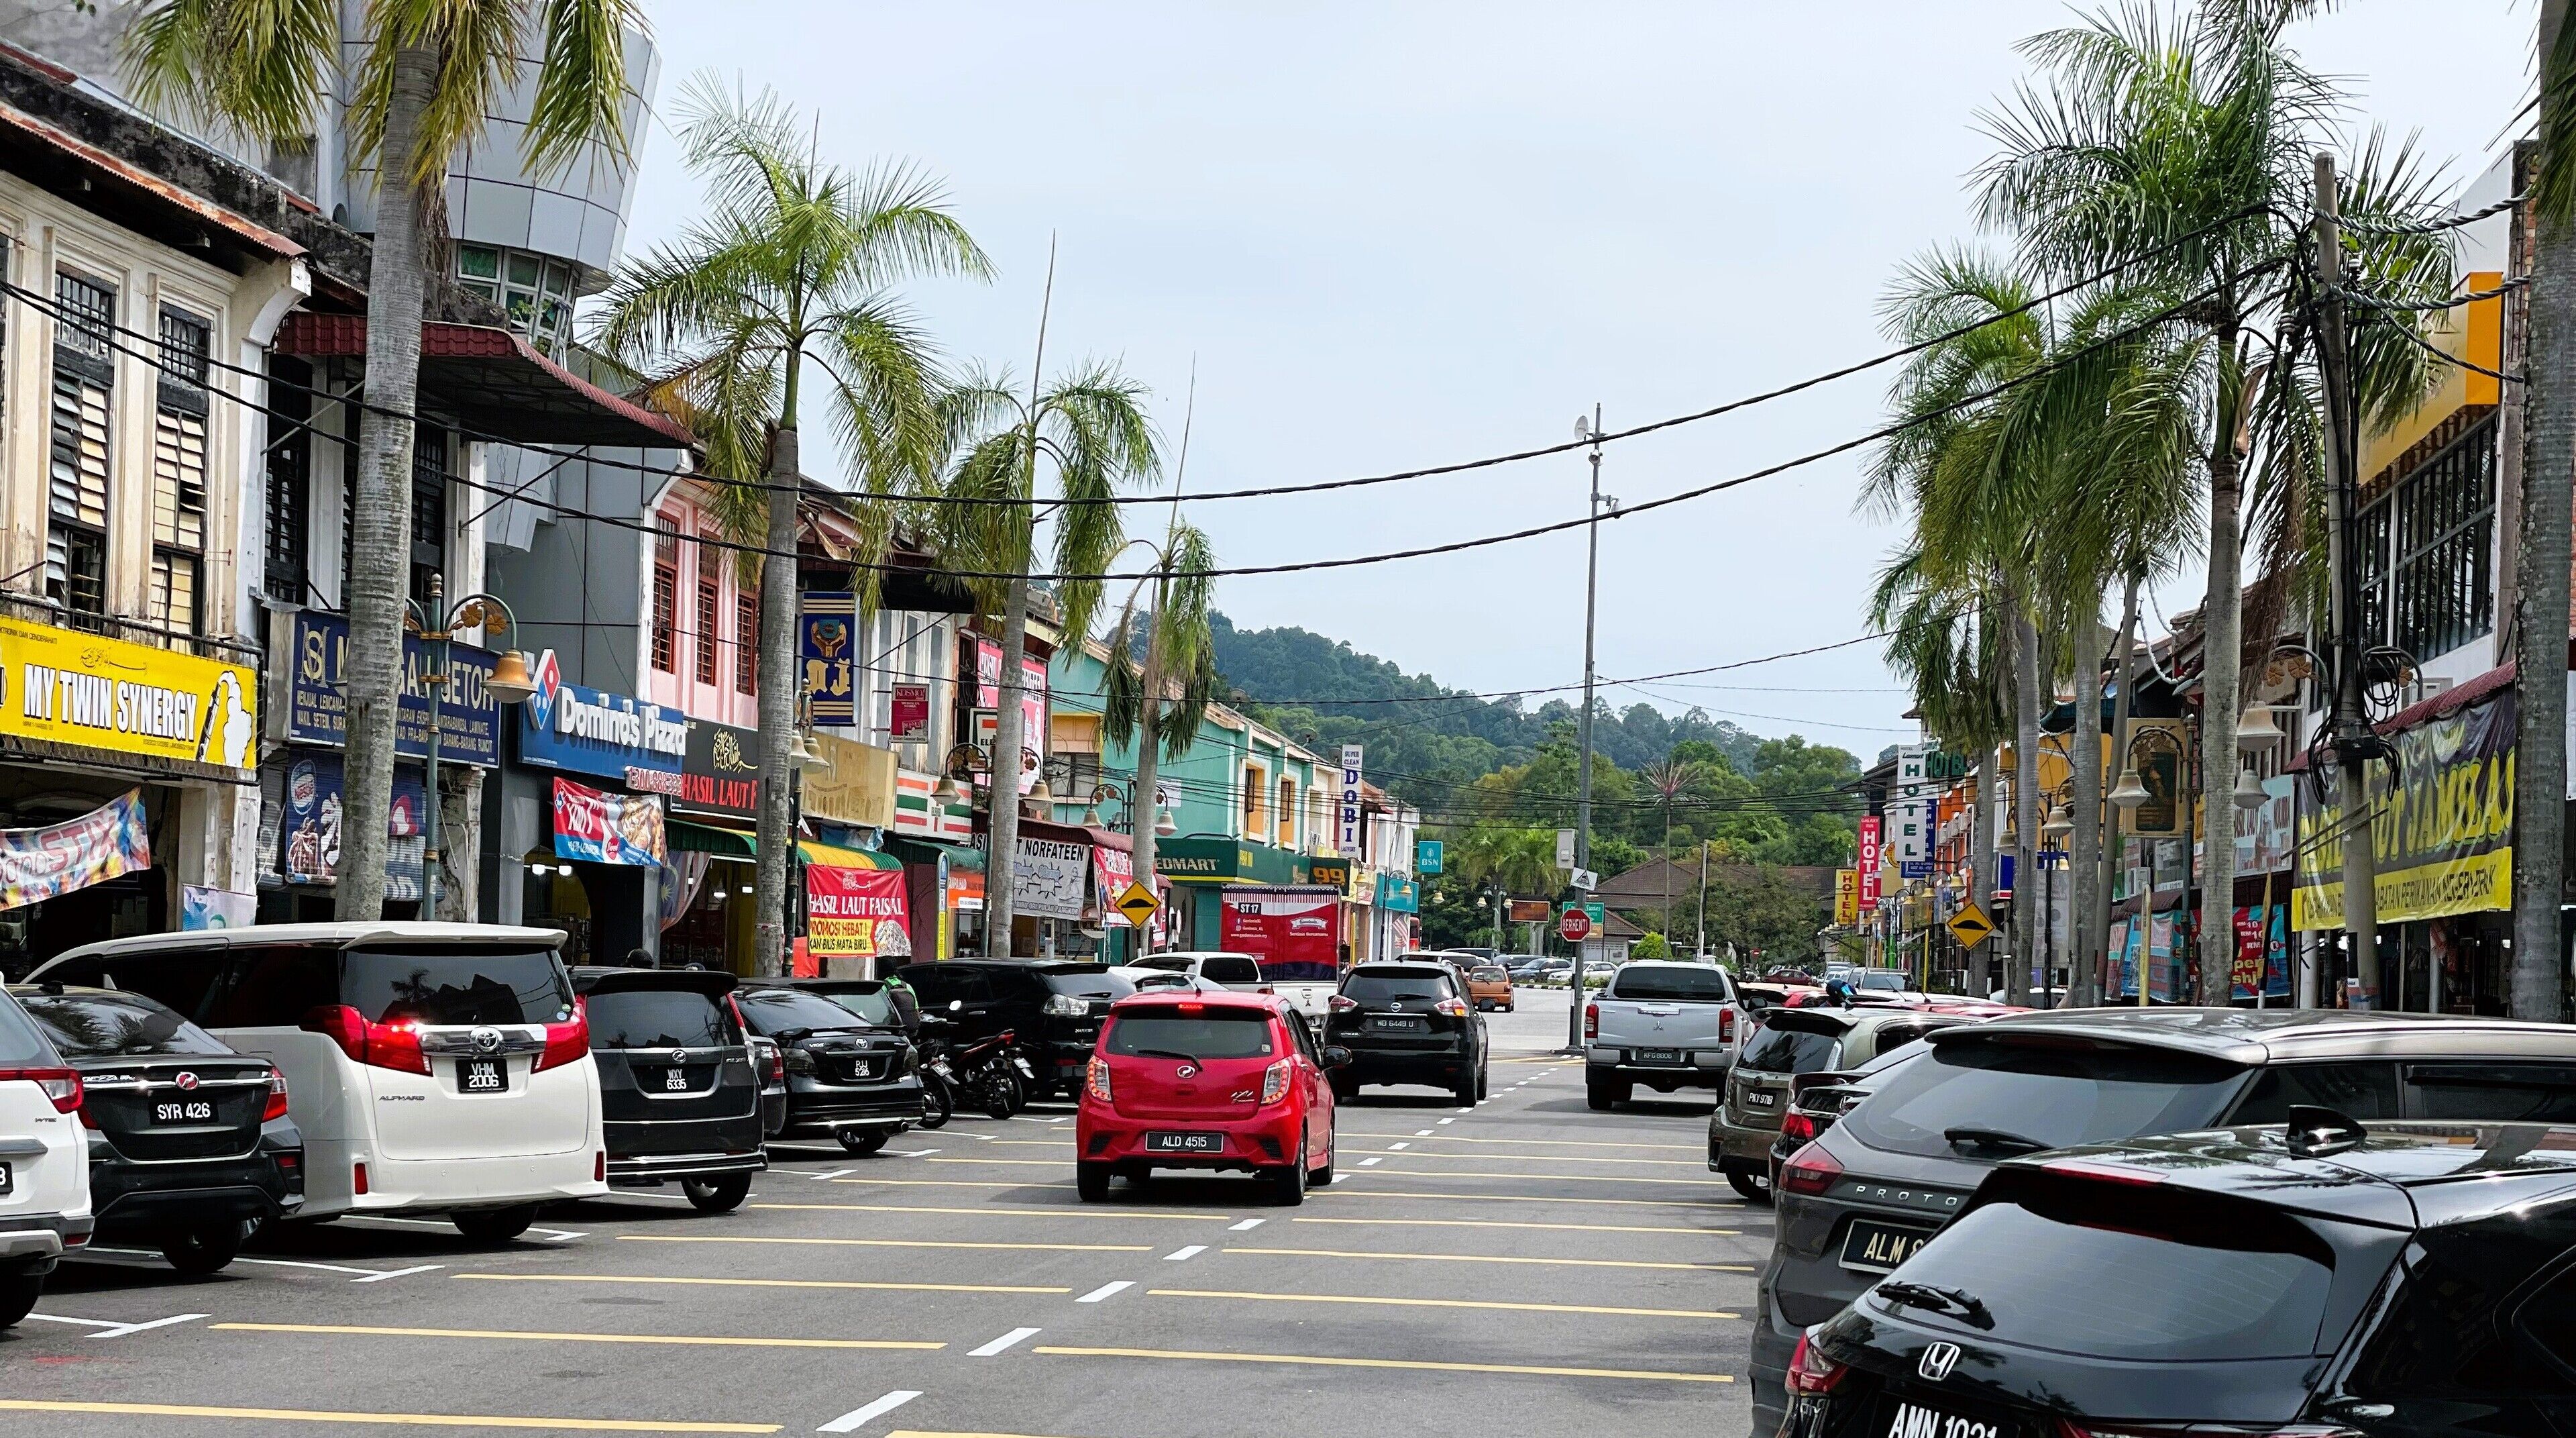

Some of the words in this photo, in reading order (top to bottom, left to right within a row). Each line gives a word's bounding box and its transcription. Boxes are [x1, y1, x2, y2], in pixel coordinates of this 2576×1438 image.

[24, 663, 56, 721] MY
[59, 669, 113, 729] TWIN
[116, 680, 198, 743] SYNERGY
[555, 686, 640, 748] Domino's
[641, 705, 688, 756] Pizza
[681, 772, 716, 805] HASIL
[718, 778, 749, 809] LAUT
[1343, 768, 1358, 842] DOBI
[1903, 764, 1920, 856] HOTEL
[1024, 839, 1085, 862] NORFATEEN
[1862, 831, 1876, 901] HOTEL
[1313, 866, 1346, 885] 99
[809, 893, 838, 914] HASIL
[841, 896, 867, 915] LAUT
[869, 897, 904, 915] FAISAL
[1241, 904, 1250, 913] ST
[1251, 904, 1259, 913] 17
[842, 922, 863, 936] HEBAT
[1563, 918, 1588, 932] BERHENTI
[822, 939, 835, 950] BILIS
[836, 939, 852, 951] MATA
[854, 939, 867, 951] BIRU
[471, 1063, 494, 1076] VHM
[667, 1068, 683, 1079] WXY
[855, 1068, 870, 1076] 526
[468, 1074, 499, 1088] 2006
[666, 1078, 687, 1090] 6335
[1748, 1092, 1760, 1103] PKY
[158, 1102, 182, 1120] SYR
[185, 1102, 211, 1119] 426
[1162, 1135, 1182, 1147] ALD
[1185, 1135, 1208, 1147] 4515
[1864, 1232, 1907, 1264] ALM
[1888, 1402, 1940, 1438] AMN
